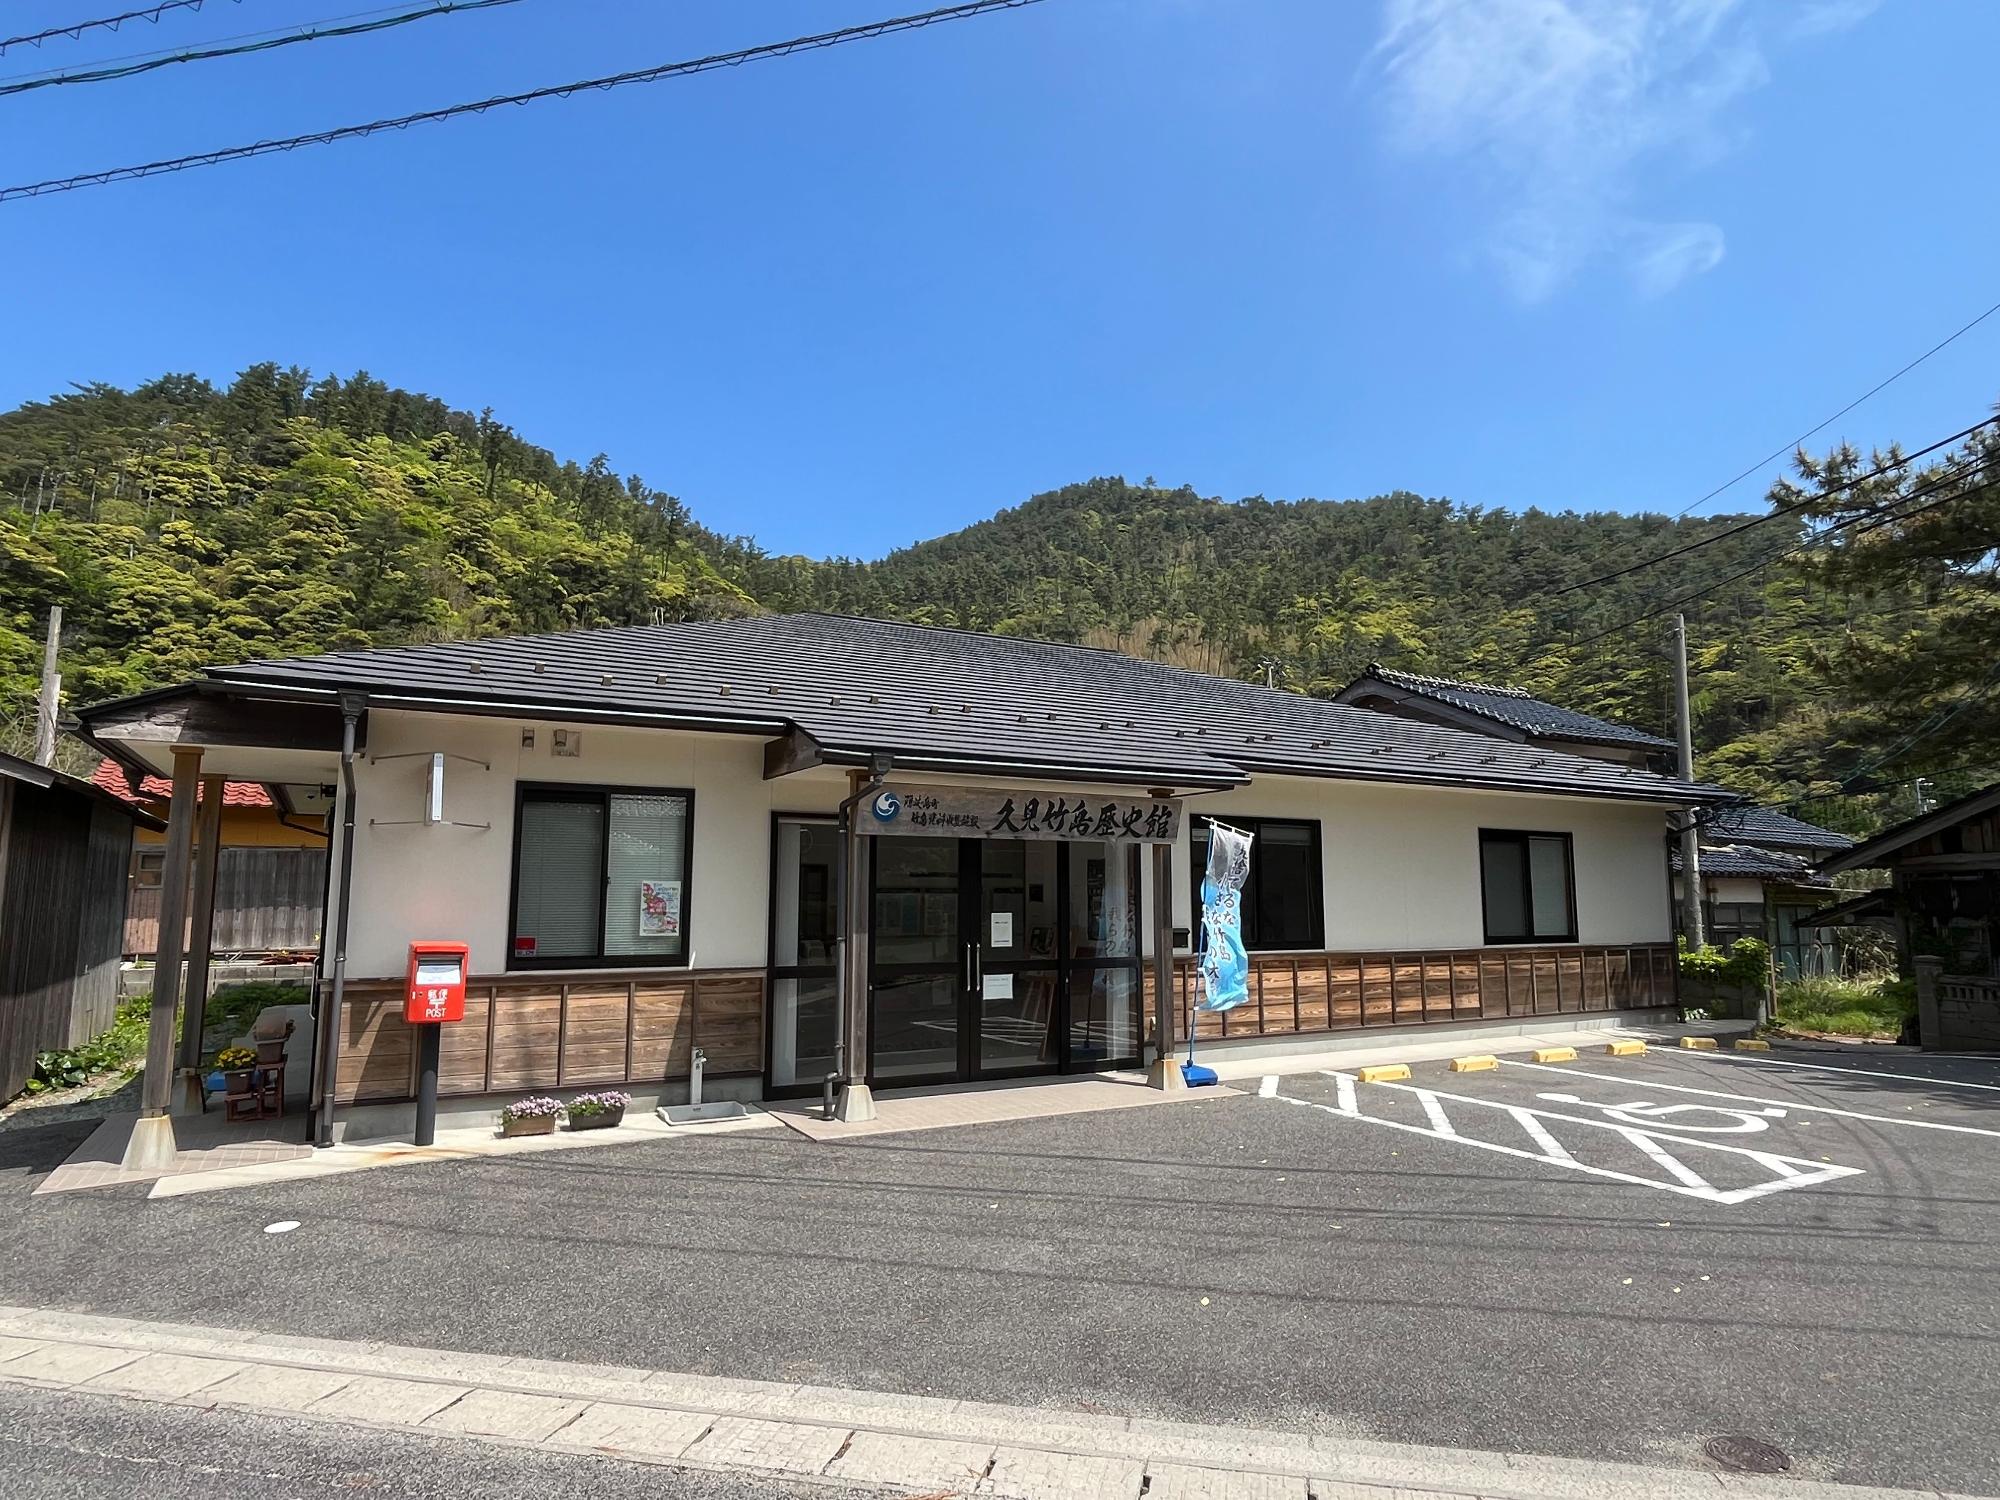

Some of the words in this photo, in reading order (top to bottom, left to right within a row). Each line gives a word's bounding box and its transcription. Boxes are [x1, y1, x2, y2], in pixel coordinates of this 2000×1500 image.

[992, 797, 1173, 839] 久見竹島歴史館
[426, 1008, 447, 1018] POST
